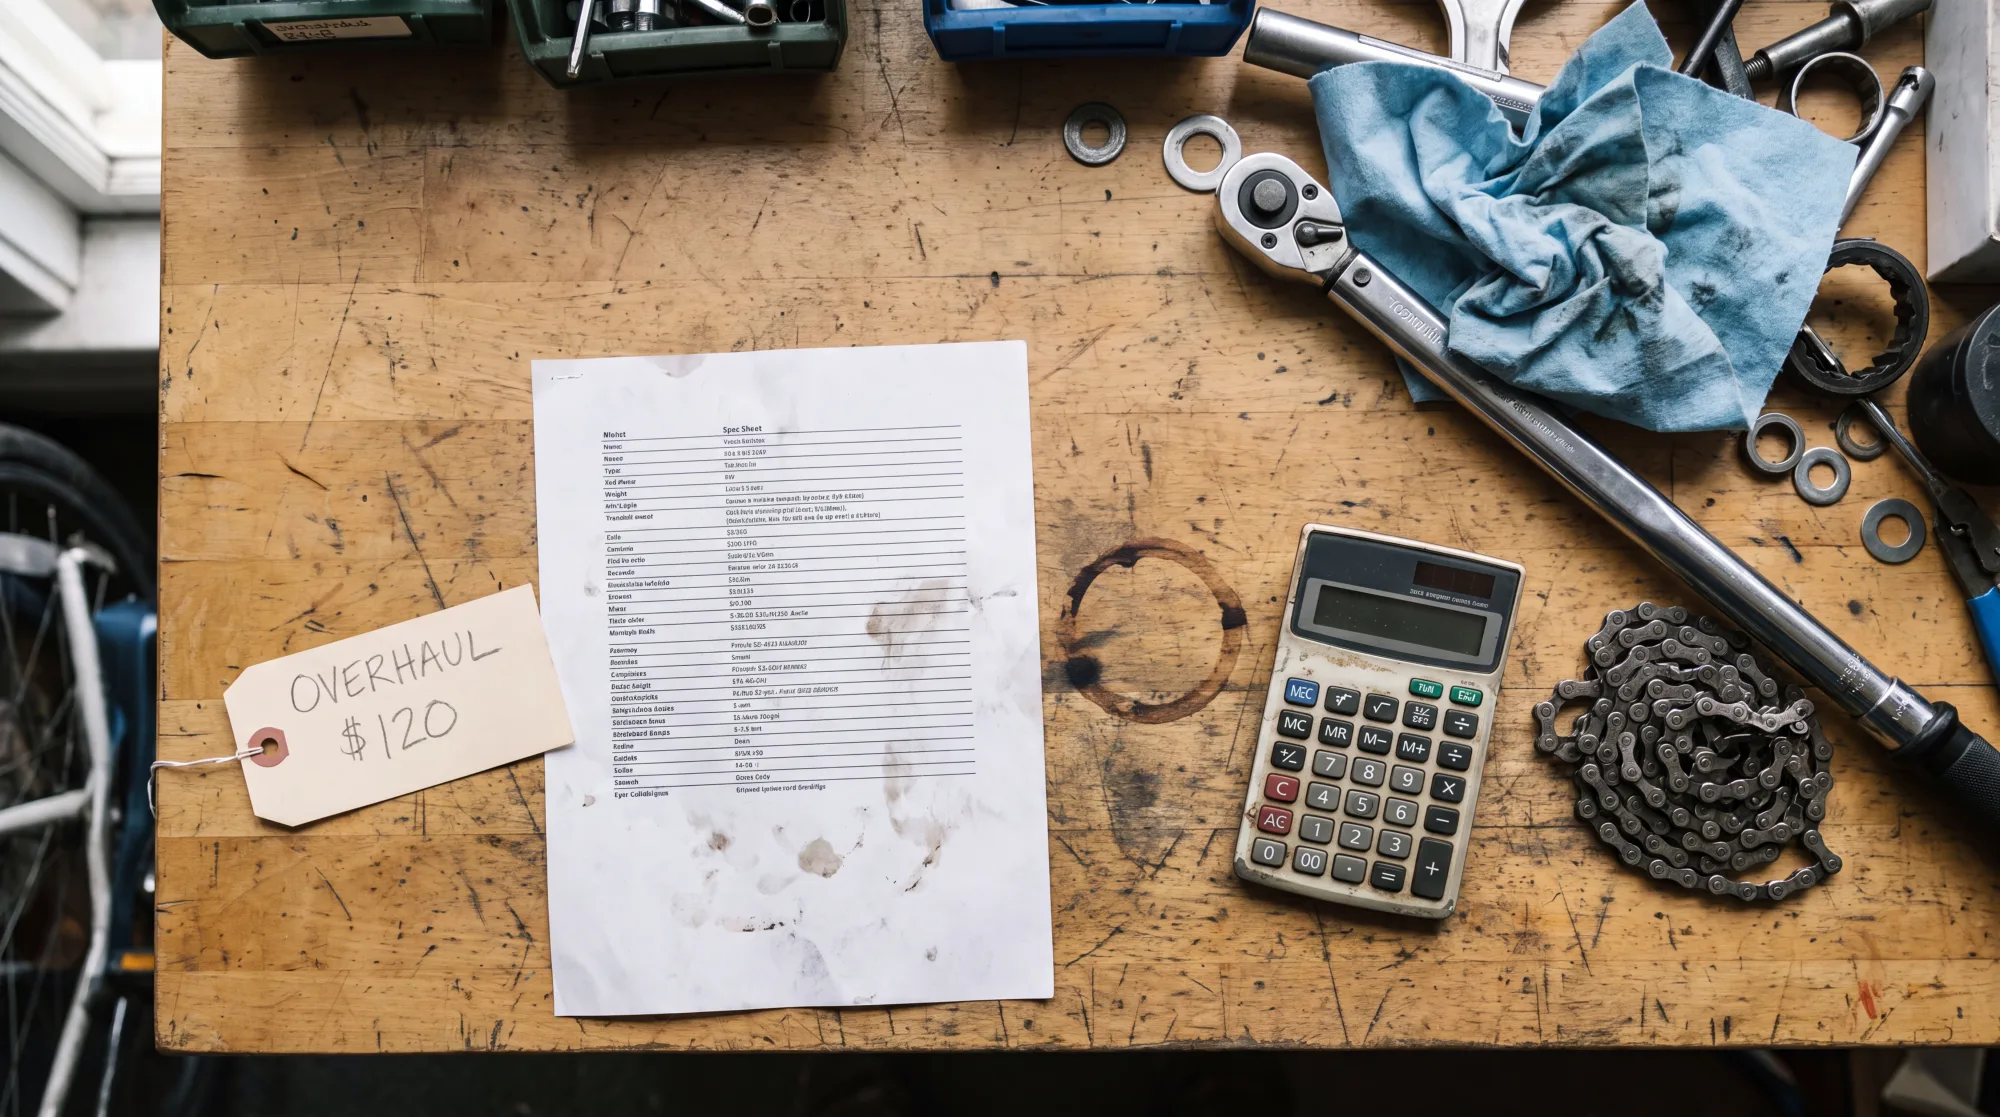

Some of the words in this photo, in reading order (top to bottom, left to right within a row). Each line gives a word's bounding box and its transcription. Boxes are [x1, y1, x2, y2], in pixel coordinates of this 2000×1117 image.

[723, 426, 739, 434] Spec
[291, 630, 502, 712] OVERHAUL
[340, 700, 457, 761] $120
[1284, 718, 1307, 731] MC
[1324, 726, 1346, 739] MR
[1402, 741, 1425, 754] M+
[1326, 757, 1335, 771] 7
[1364, 765, 1374, 779] 8
[1403, 773, 1413, 787] 9
[1276, 782, 1288, 795] C
[1318, 790, 1328, 804] 4
[1357, 798, 1366, 812] 5
[1396, 805, 1406, 819] 6
[1313, 823, 1320, 836] 1
[1351, 830, 1360, 843] 2
[1390, 838, 1400, 851] 3
[1264, 847, 1274, 860] 0
[1301, 854, 1320, 868] 00
